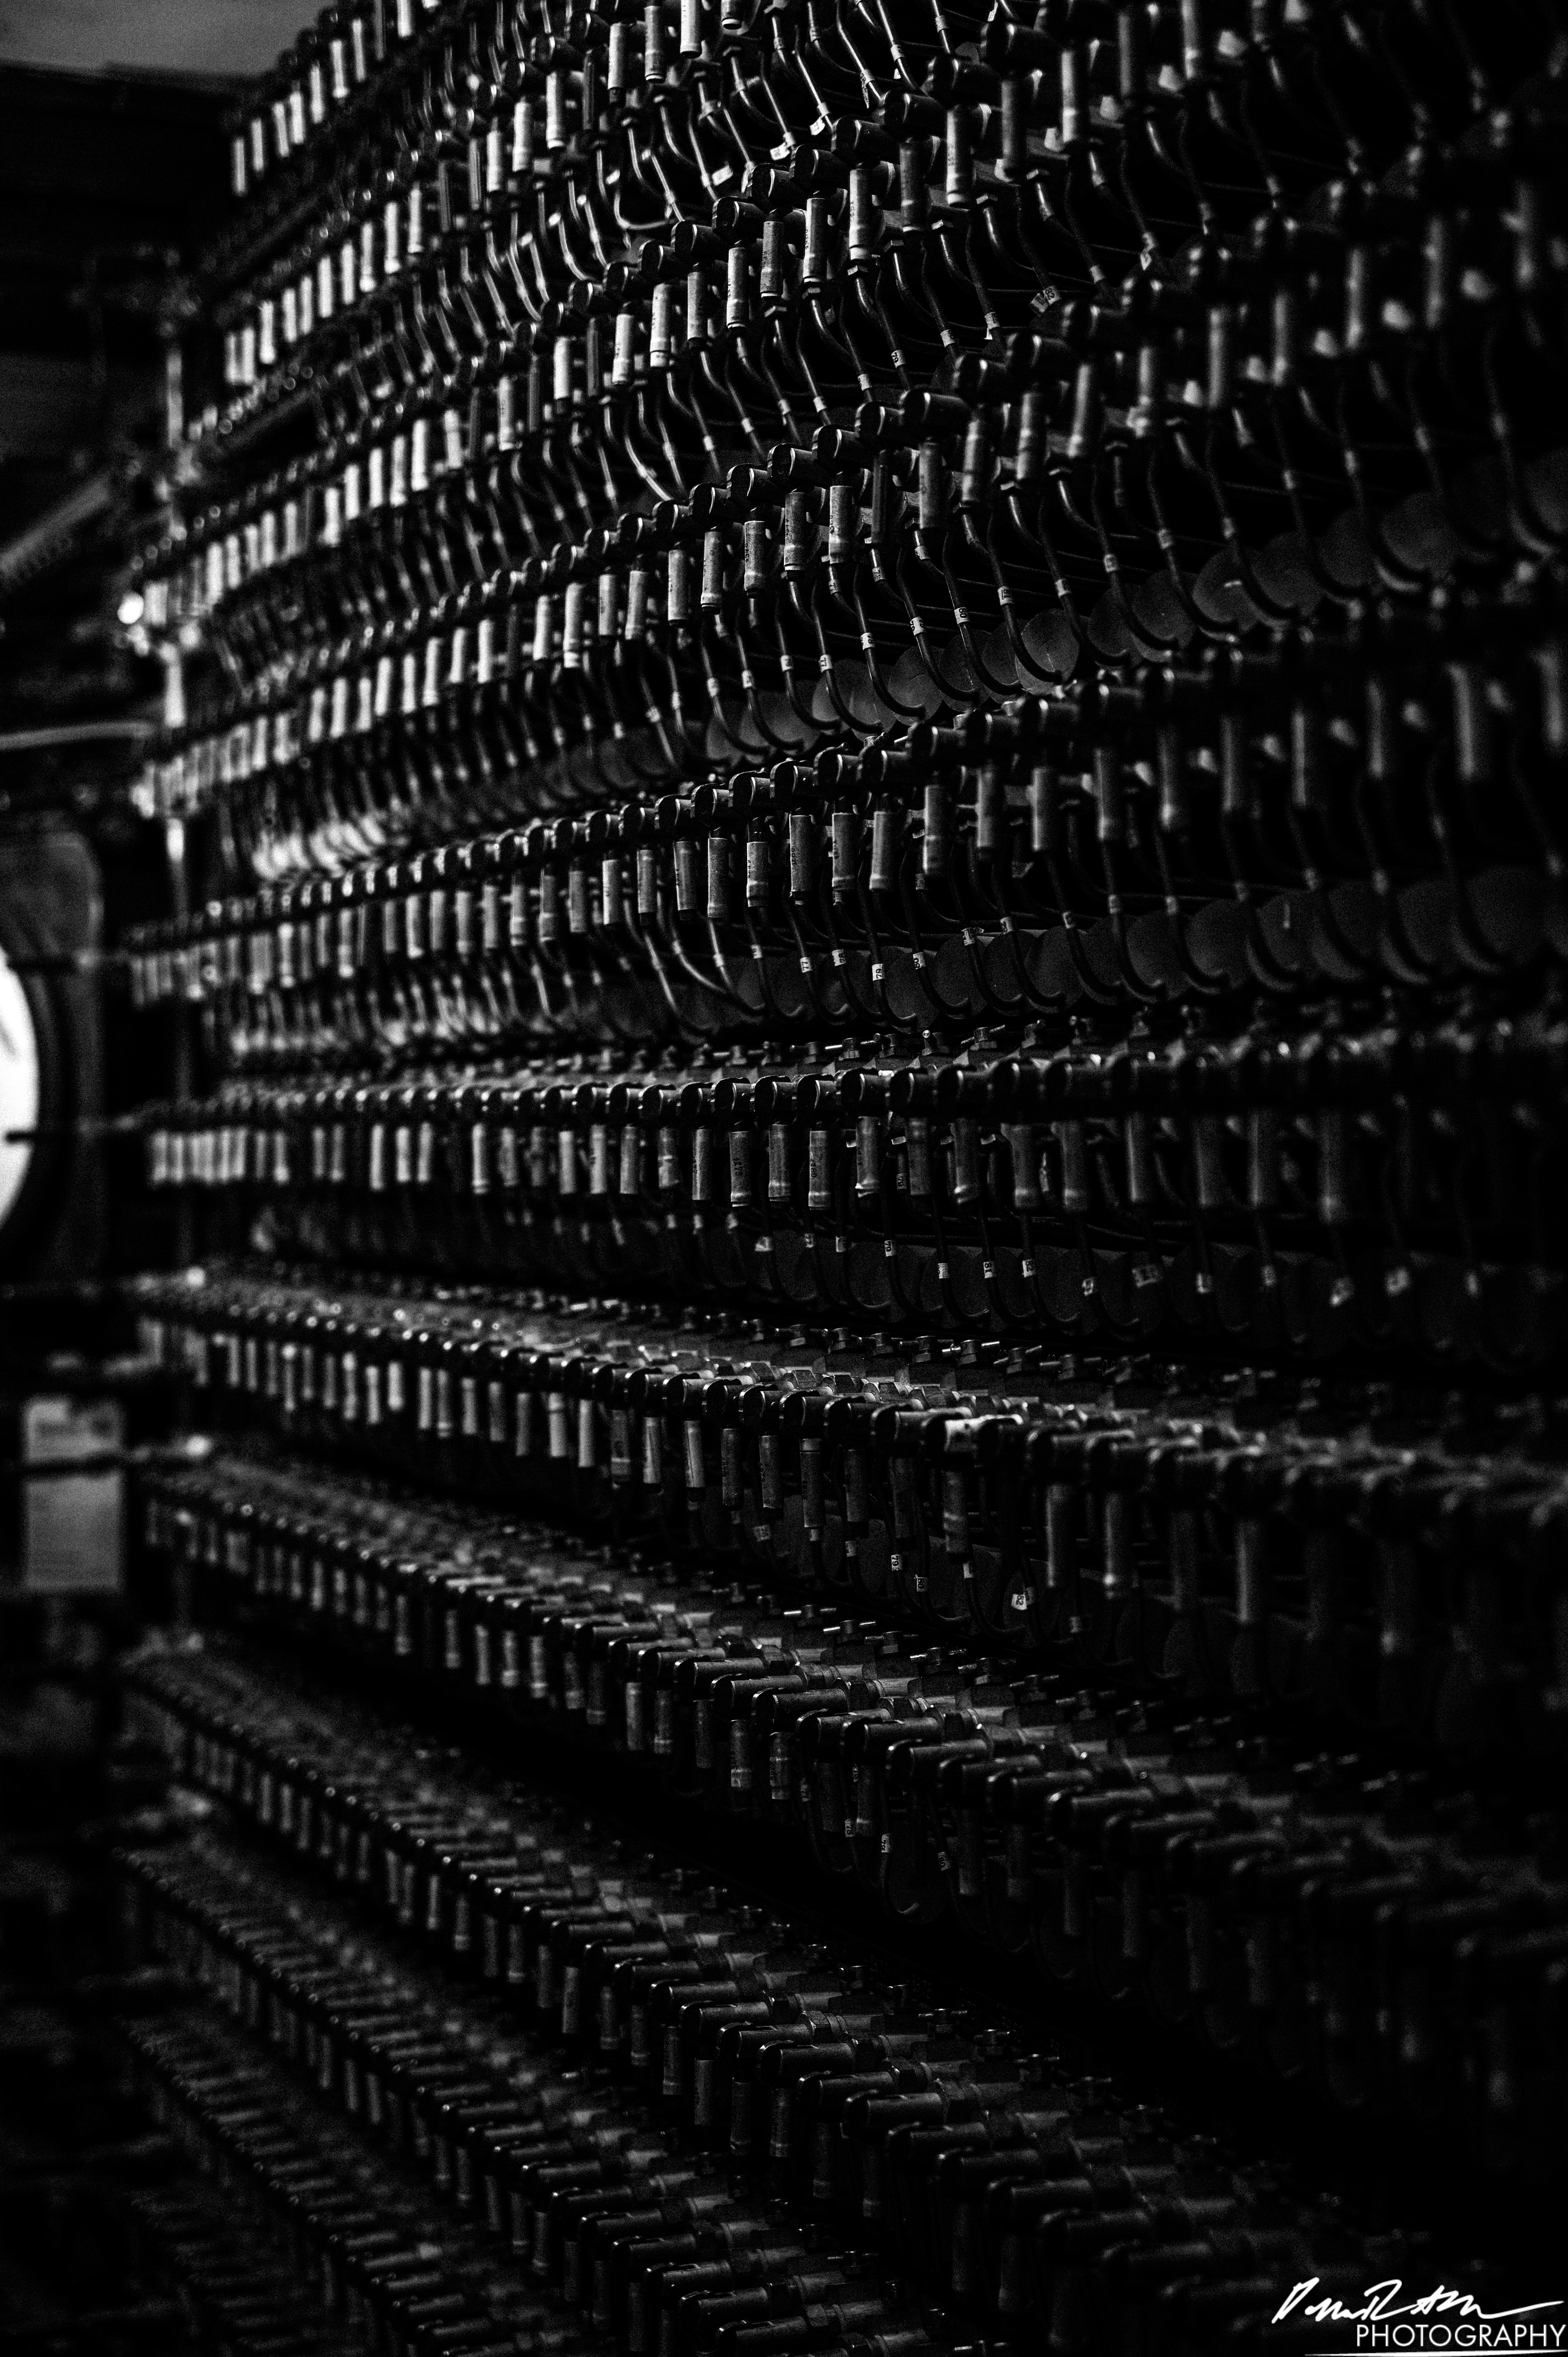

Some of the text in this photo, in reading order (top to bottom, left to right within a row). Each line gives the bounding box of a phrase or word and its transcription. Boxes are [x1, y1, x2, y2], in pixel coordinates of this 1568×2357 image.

[1045, 288, 1055, 300] 82
[891, 352, 899, 363] 79
[959, 608, 967, 618] 80
[875, 968, 882, 979] 79
[885, 1242, 892, 1252] 79
[984, 1263, 992, 1273] 81
[891, 1556, 899, 1566] 79
[918, 1578, 925, 1589] 80
